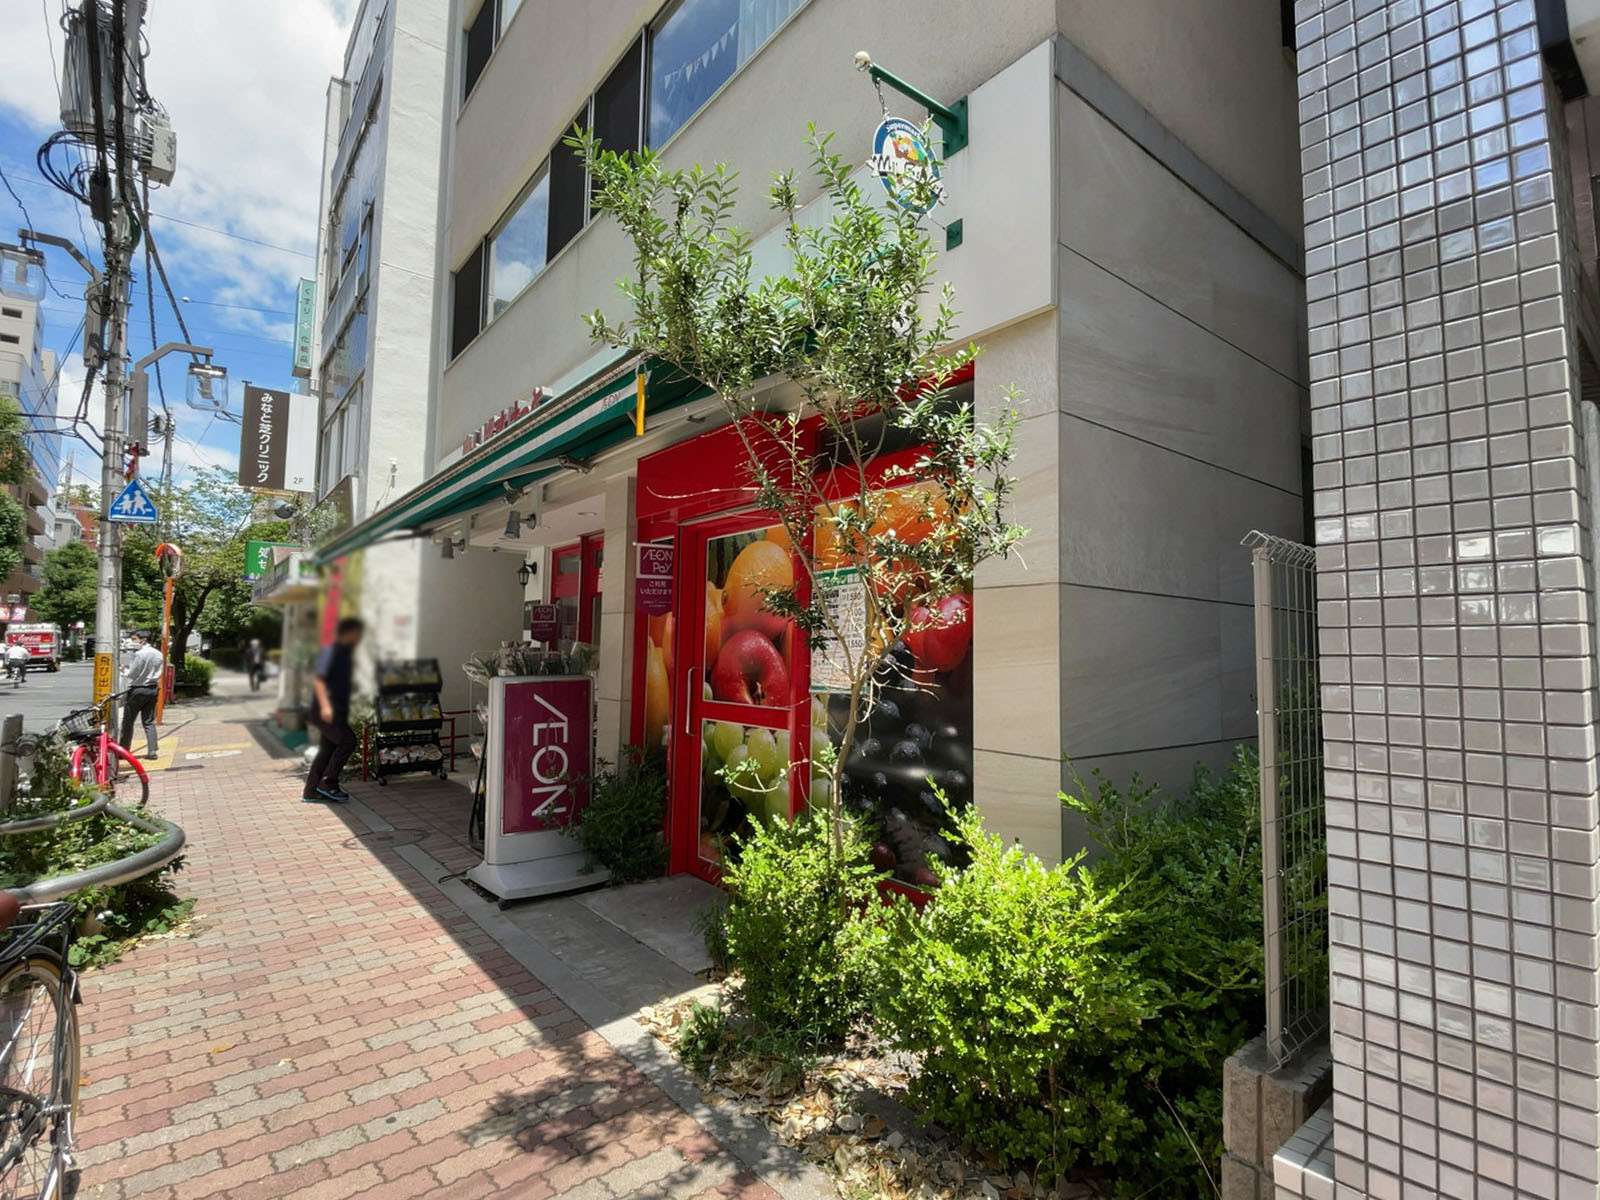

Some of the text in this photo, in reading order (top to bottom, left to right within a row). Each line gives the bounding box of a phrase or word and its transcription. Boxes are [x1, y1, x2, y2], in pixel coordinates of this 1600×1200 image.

[257, 393, 273, 483] みなと芝クリニック
